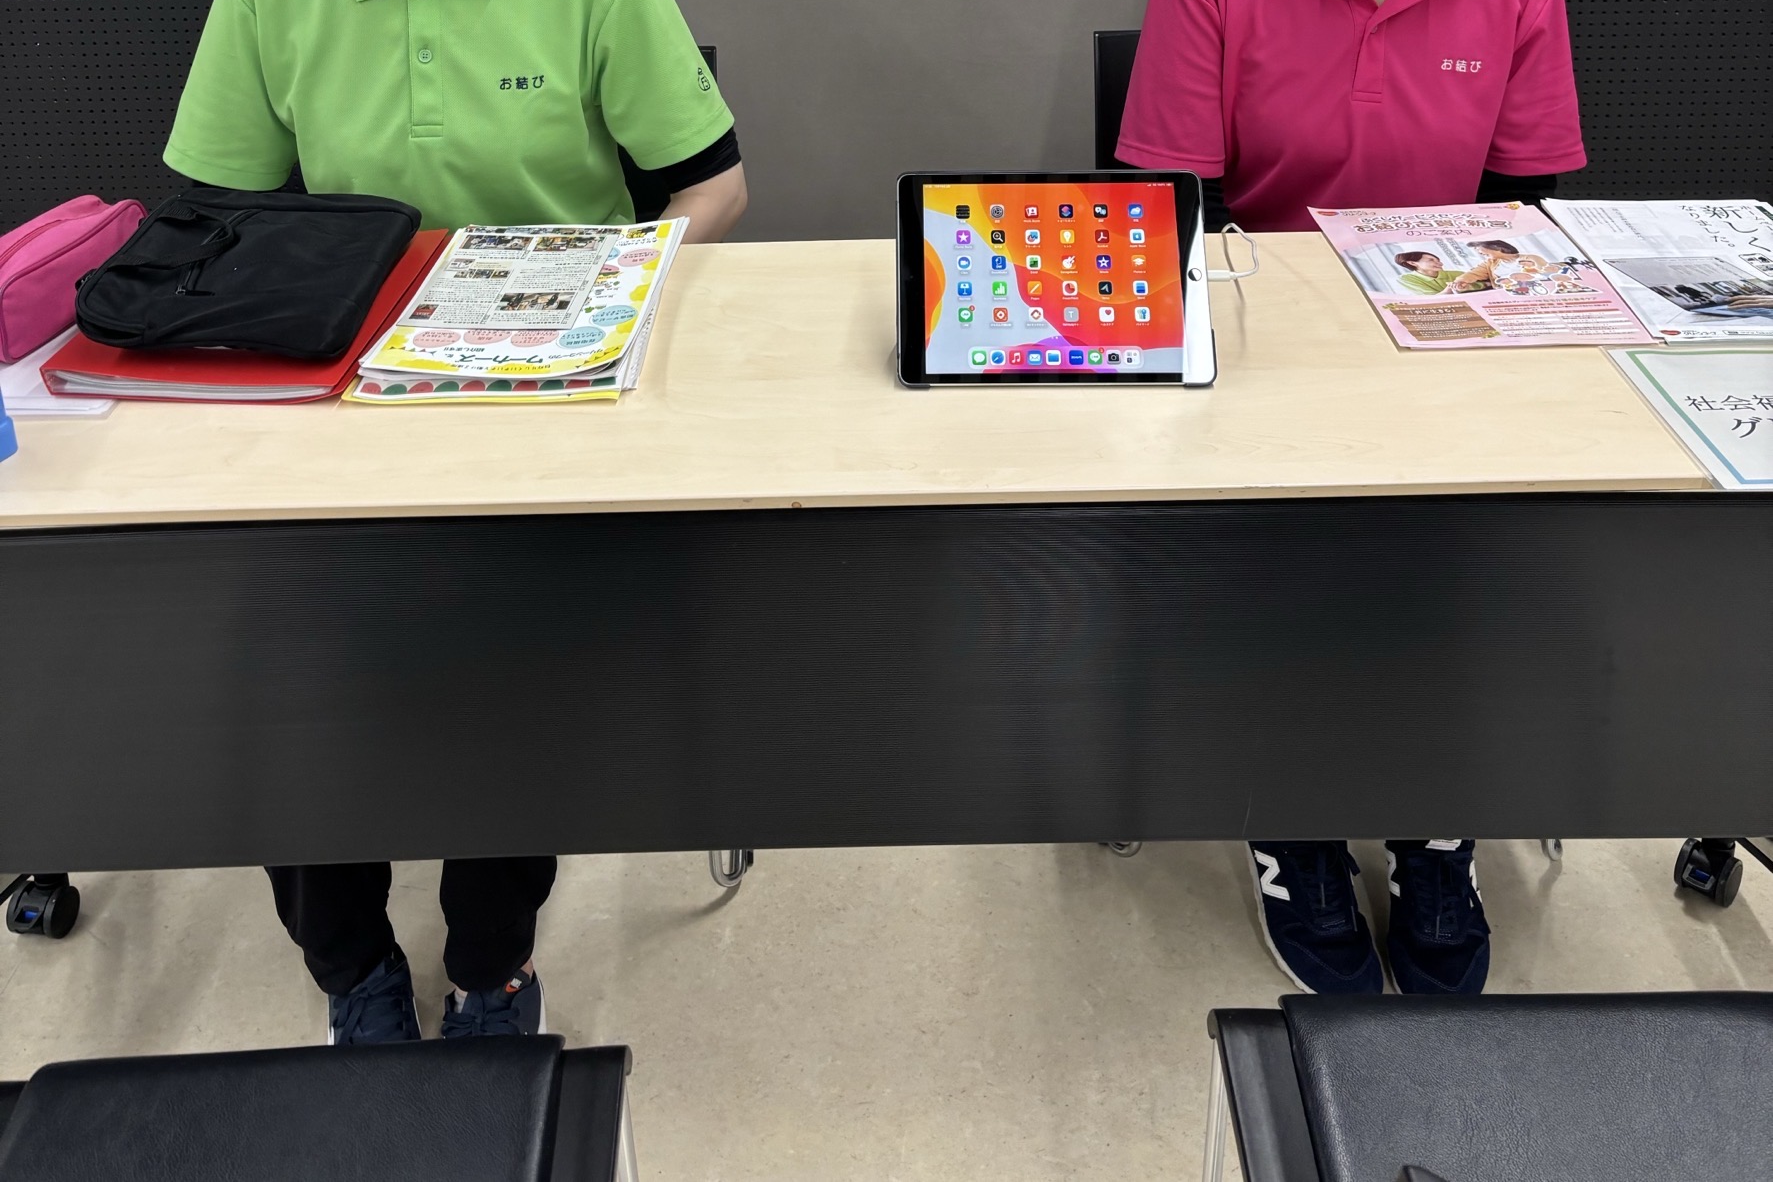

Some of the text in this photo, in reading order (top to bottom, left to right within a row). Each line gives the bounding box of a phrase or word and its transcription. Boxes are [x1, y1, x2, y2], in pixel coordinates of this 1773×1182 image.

[1441, 59, 1481, 73] お結び
[499, 75, 545, 90] お結び
[1731, 416, 1773, 439] グ
